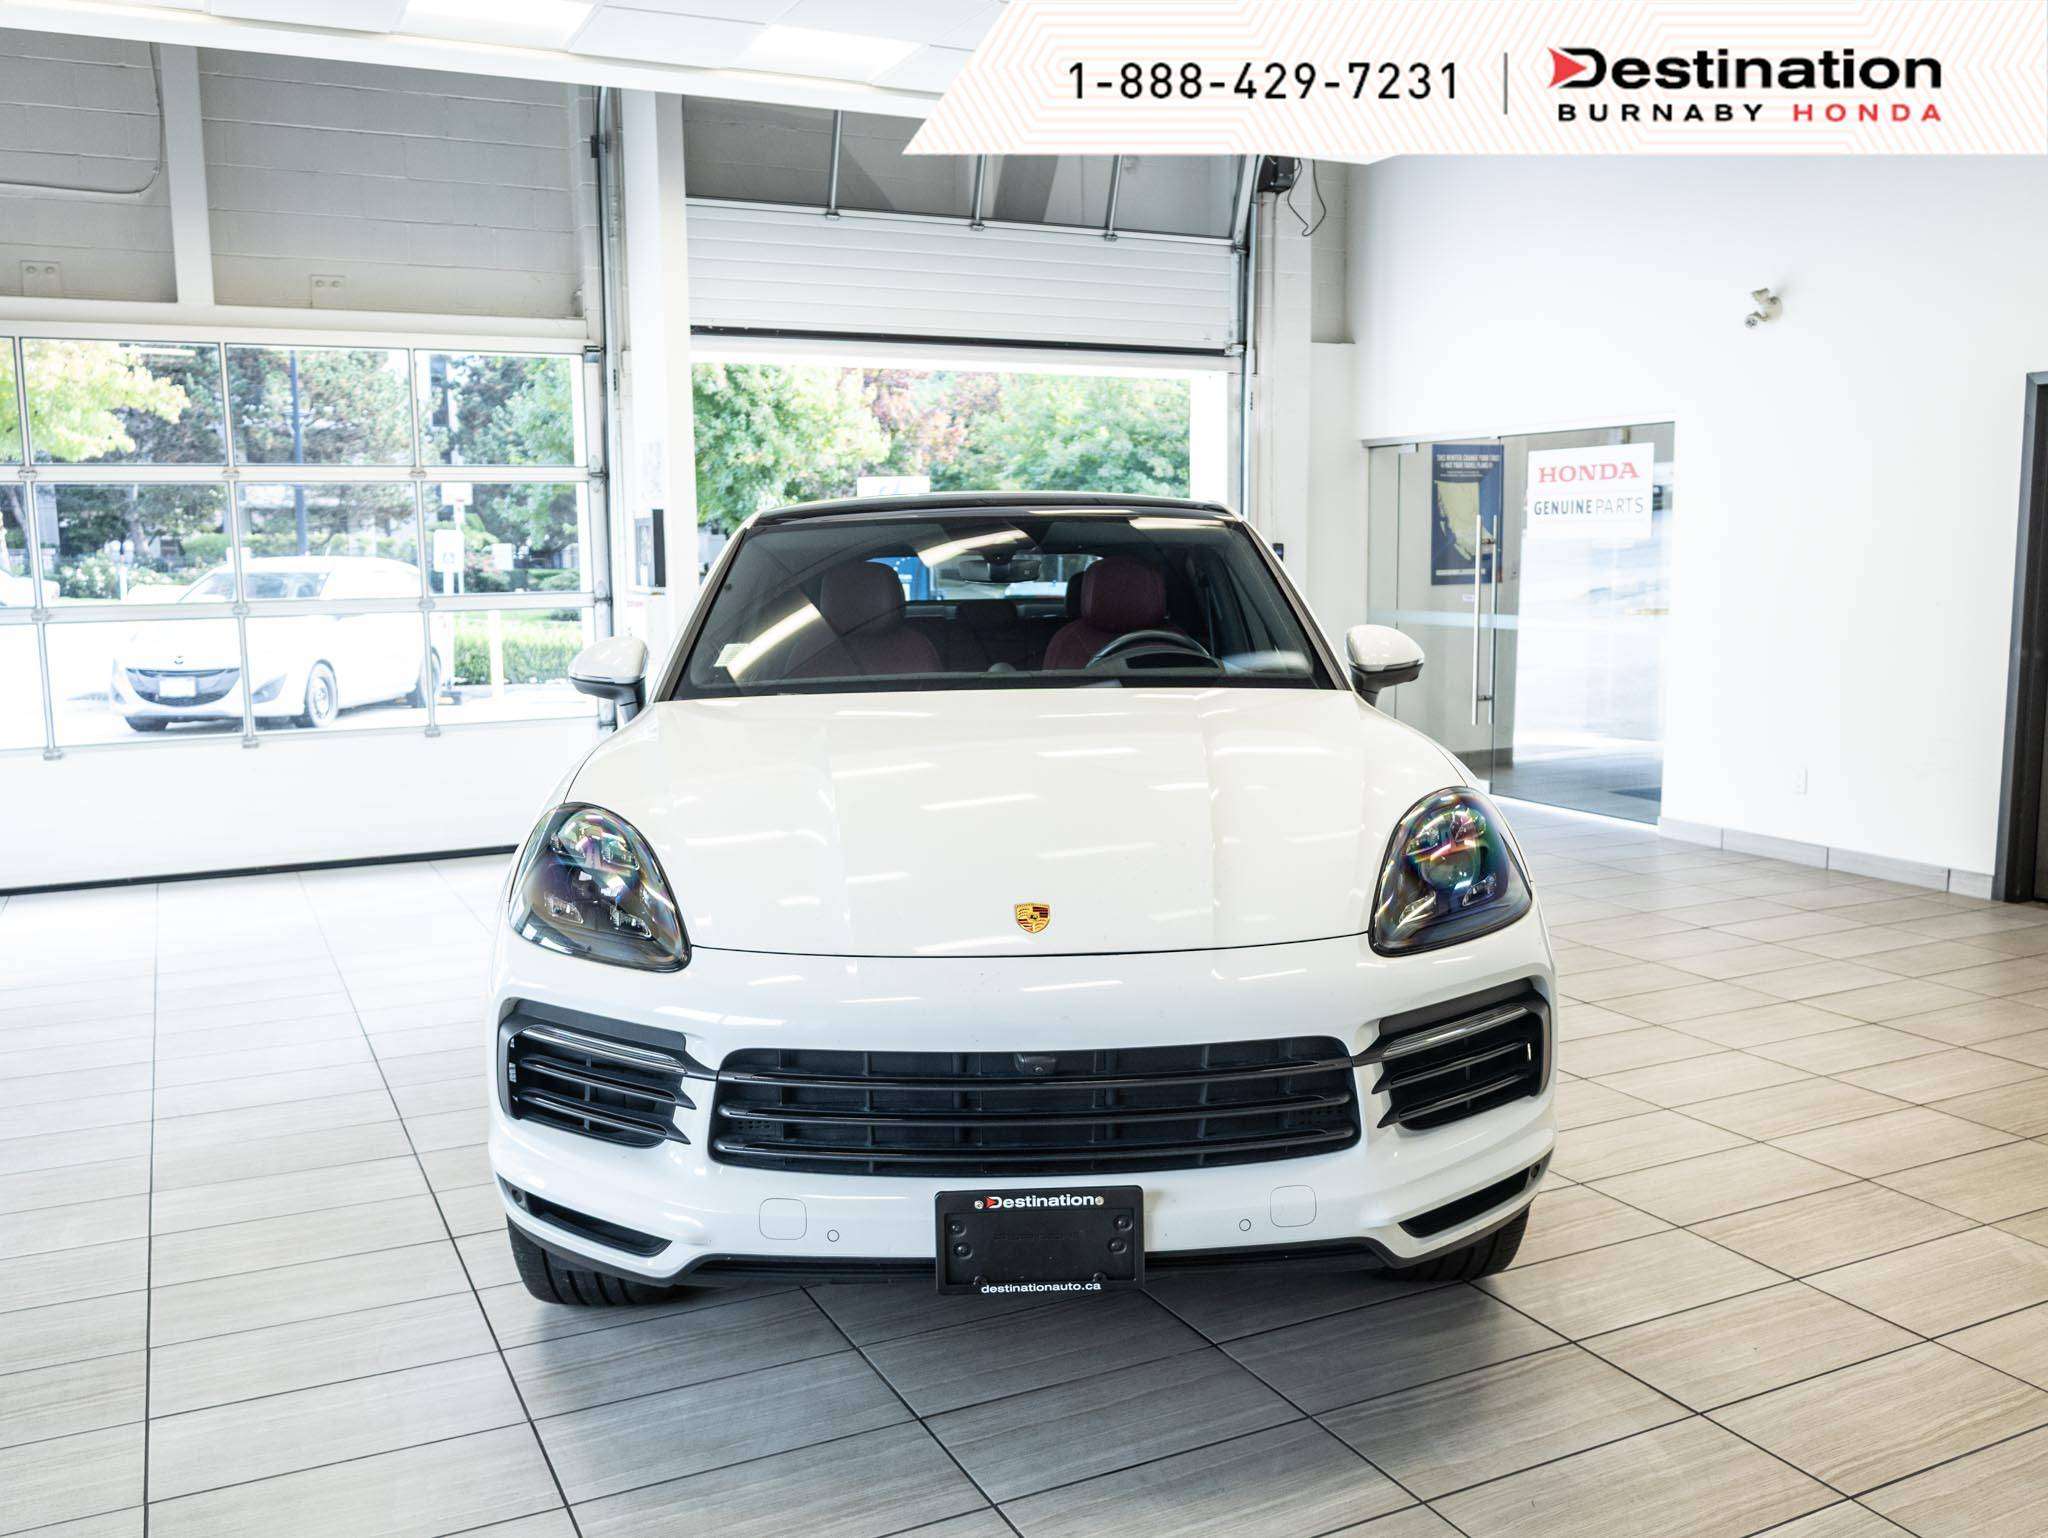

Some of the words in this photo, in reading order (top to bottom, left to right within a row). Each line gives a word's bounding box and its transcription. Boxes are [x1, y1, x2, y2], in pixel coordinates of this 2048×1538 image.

[1539, 461, 1640, 483] HONDA
[1533, 499, 1593, 516] GENUINE
[1595, 497, 1644, 514] PARTS
[985, 1194, 1095, 1209] Destination
[981, 1280, 1102, 1294] destinationauto.ca
